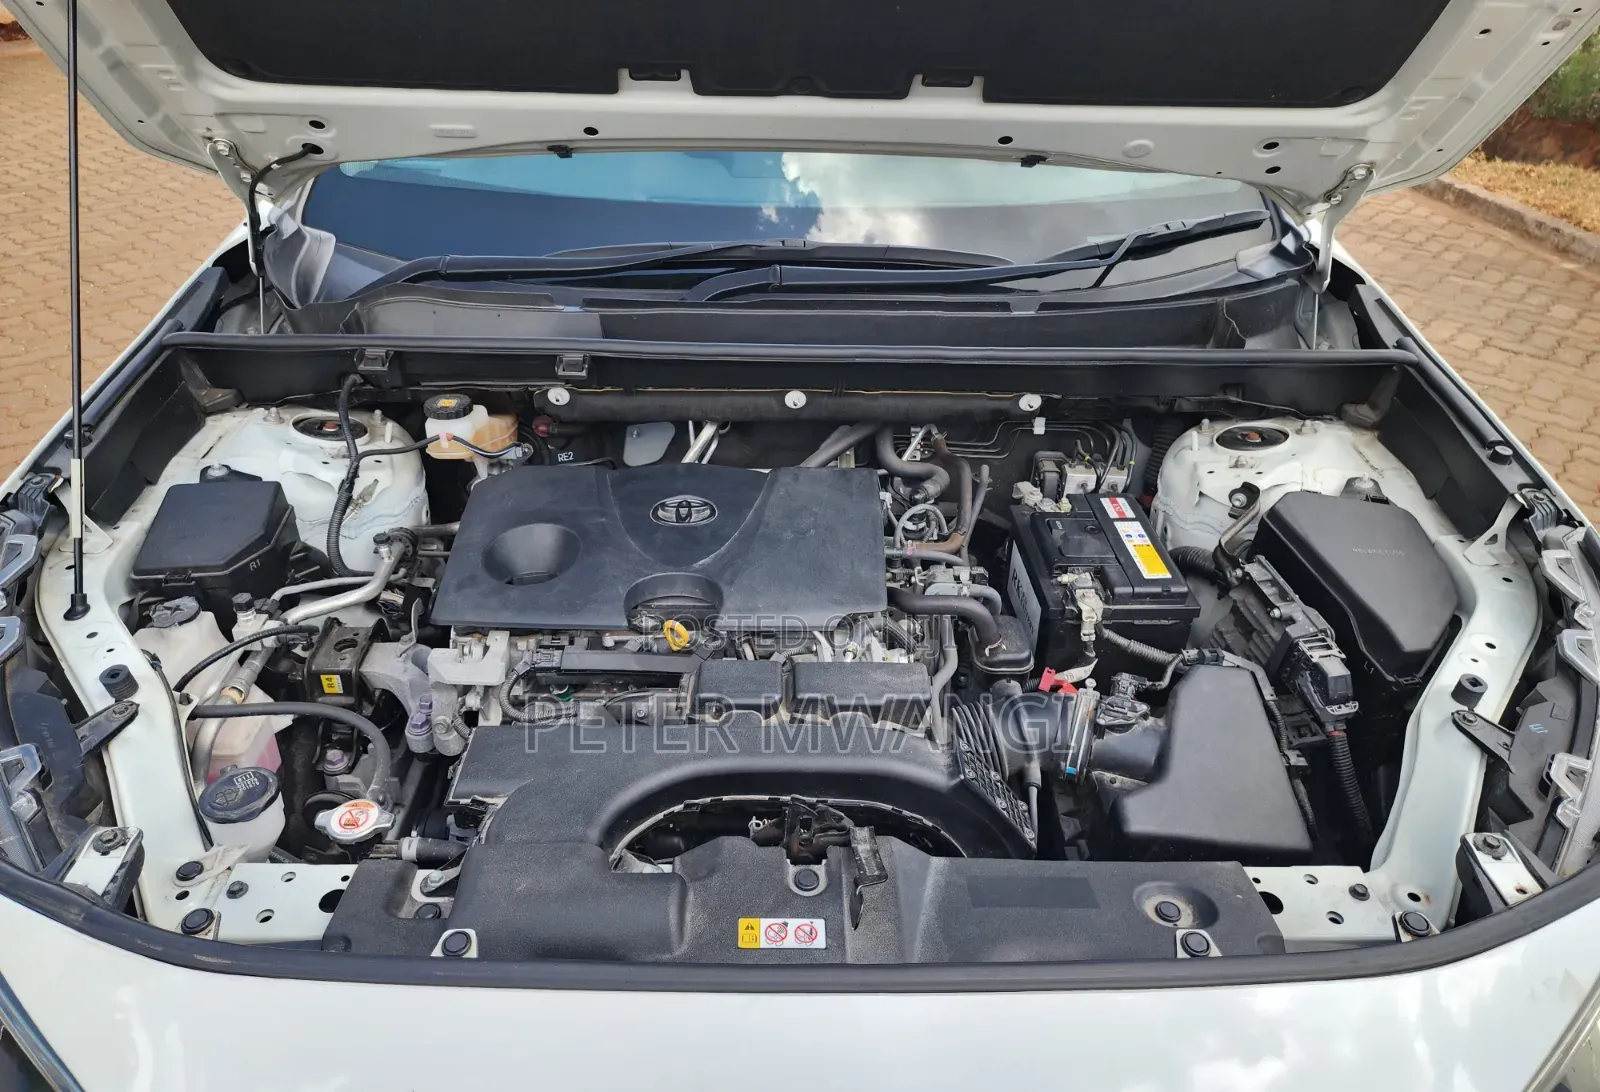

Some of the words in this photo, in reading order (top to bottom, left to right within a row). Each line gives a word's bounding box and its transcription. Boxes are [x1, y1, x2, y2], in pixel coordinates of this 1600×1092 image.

[557, 451, 574, 462] RE2
[249, 559, 260, 571] R1
[325, 677, 336, 688] R4
